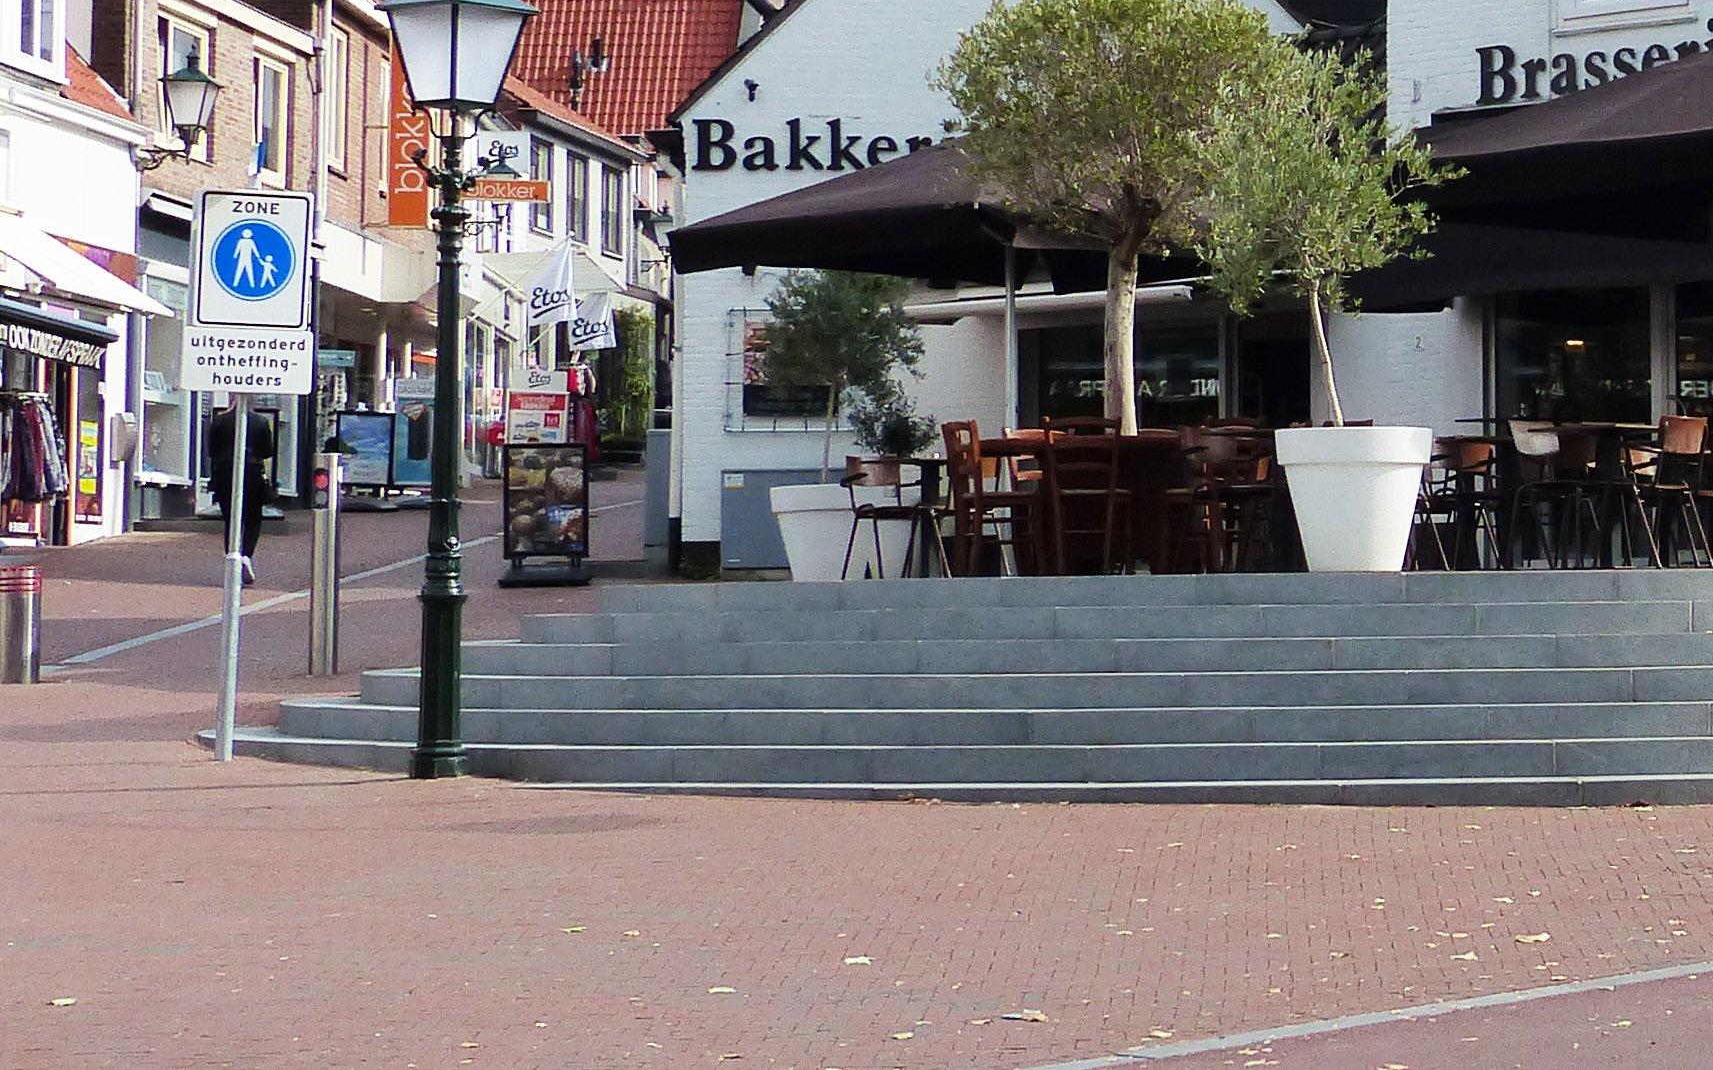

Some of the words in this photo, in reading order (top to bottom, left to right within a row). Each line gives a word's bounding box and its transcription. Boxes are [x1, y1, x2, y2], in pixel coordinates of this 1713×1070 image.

[395, 81, 424, 194] blokk
[691, 117, 934, 172] Bakker
[489, 140, 519, 158] Etos
[232, 200, 280, 215] ZONE
[531, 287, 571, 309] Etos
[572, 317, 608, 338] Etos
[191, 335, 306, 351] uitgezonderd
[197, 354, 298, 371] ontheffing-
[212, 372, 282, 386] houders
